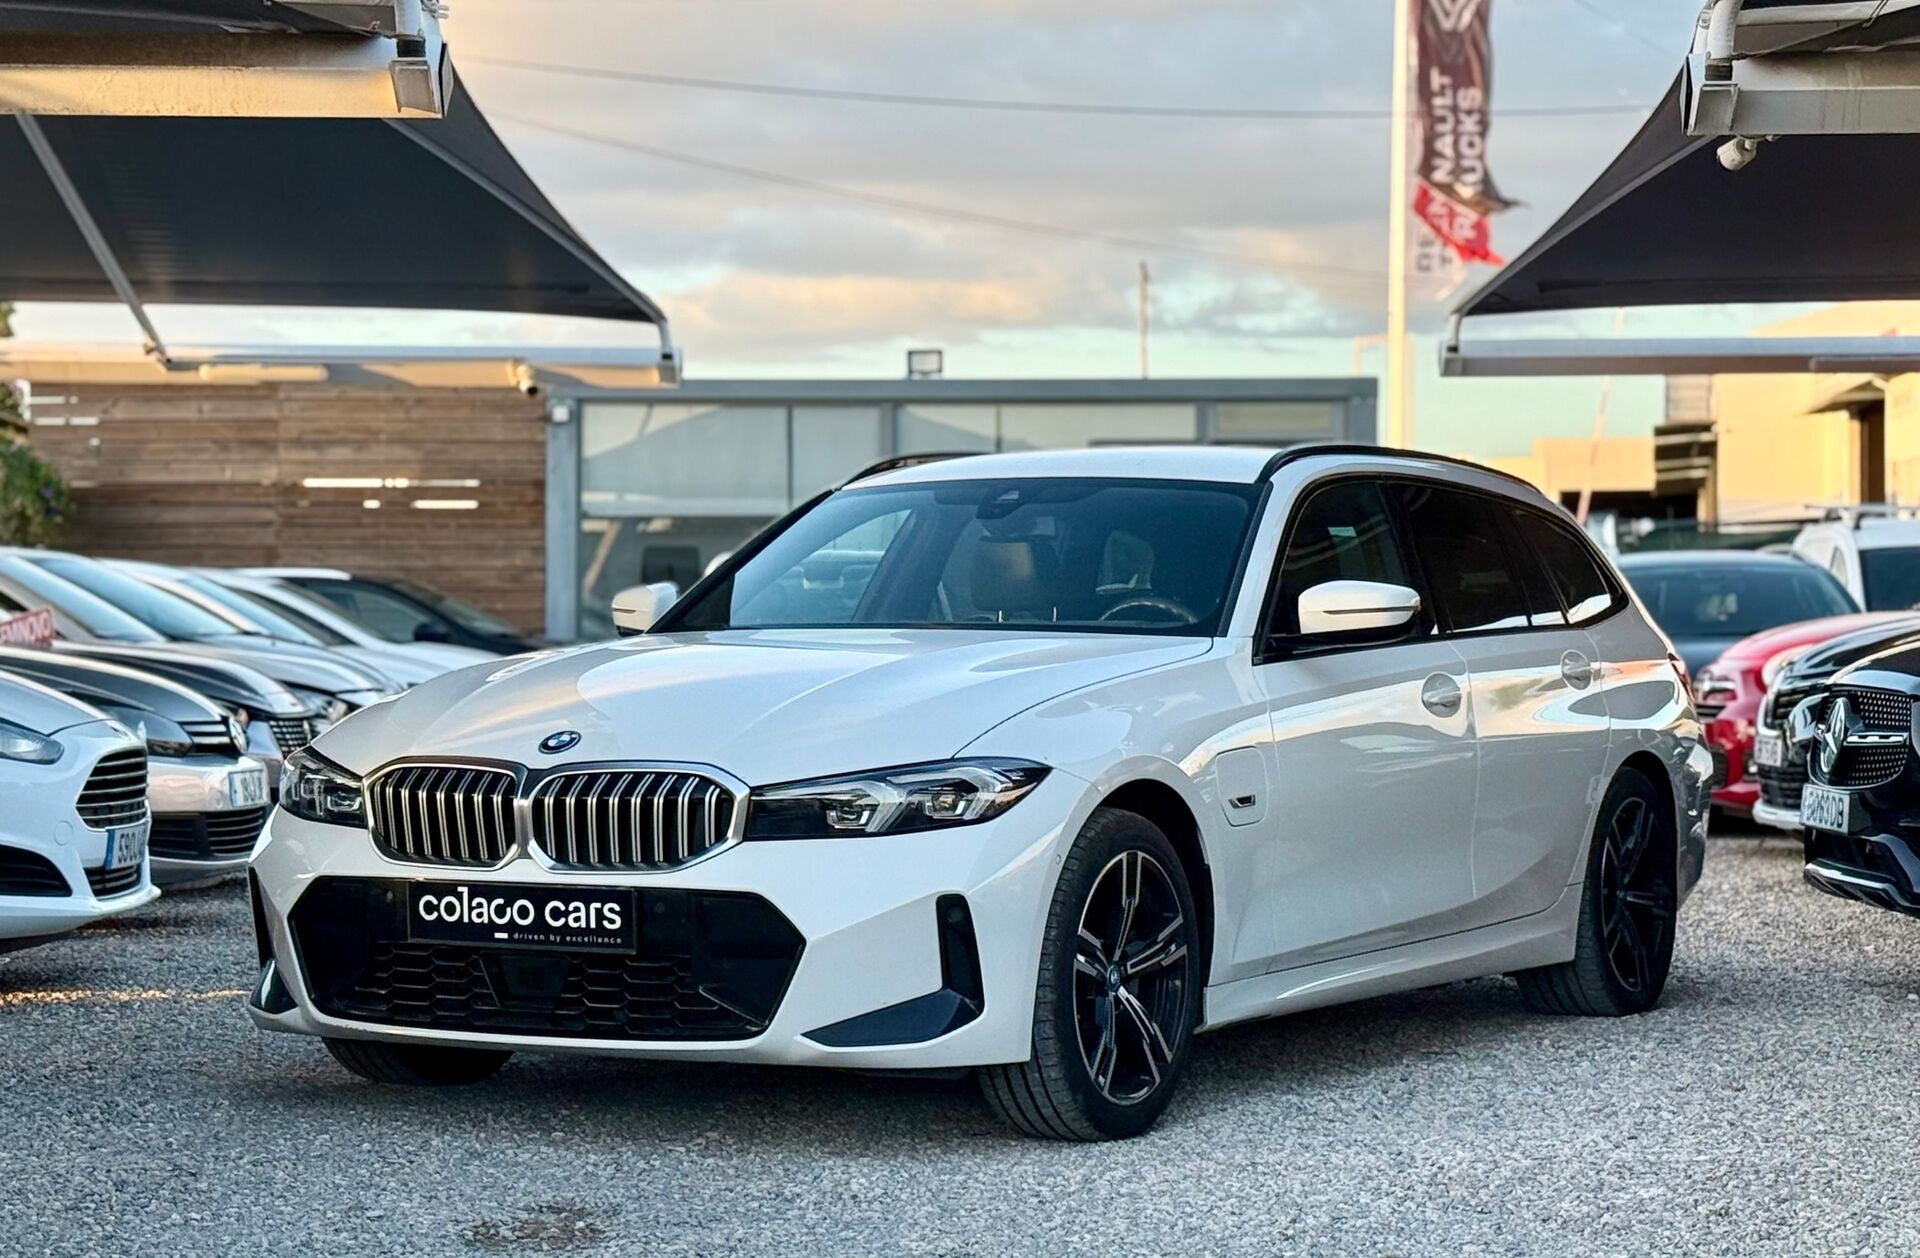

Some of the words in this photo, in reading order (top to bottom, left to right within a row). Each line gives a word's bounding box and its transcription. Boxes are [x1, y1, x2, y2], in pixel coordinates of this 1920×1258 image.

[544, 900, 622, 930] cars
[513, 932, 545, 941] driven
[549, 933, 561, 943] by
[566, 934, 622, 944] excellence
